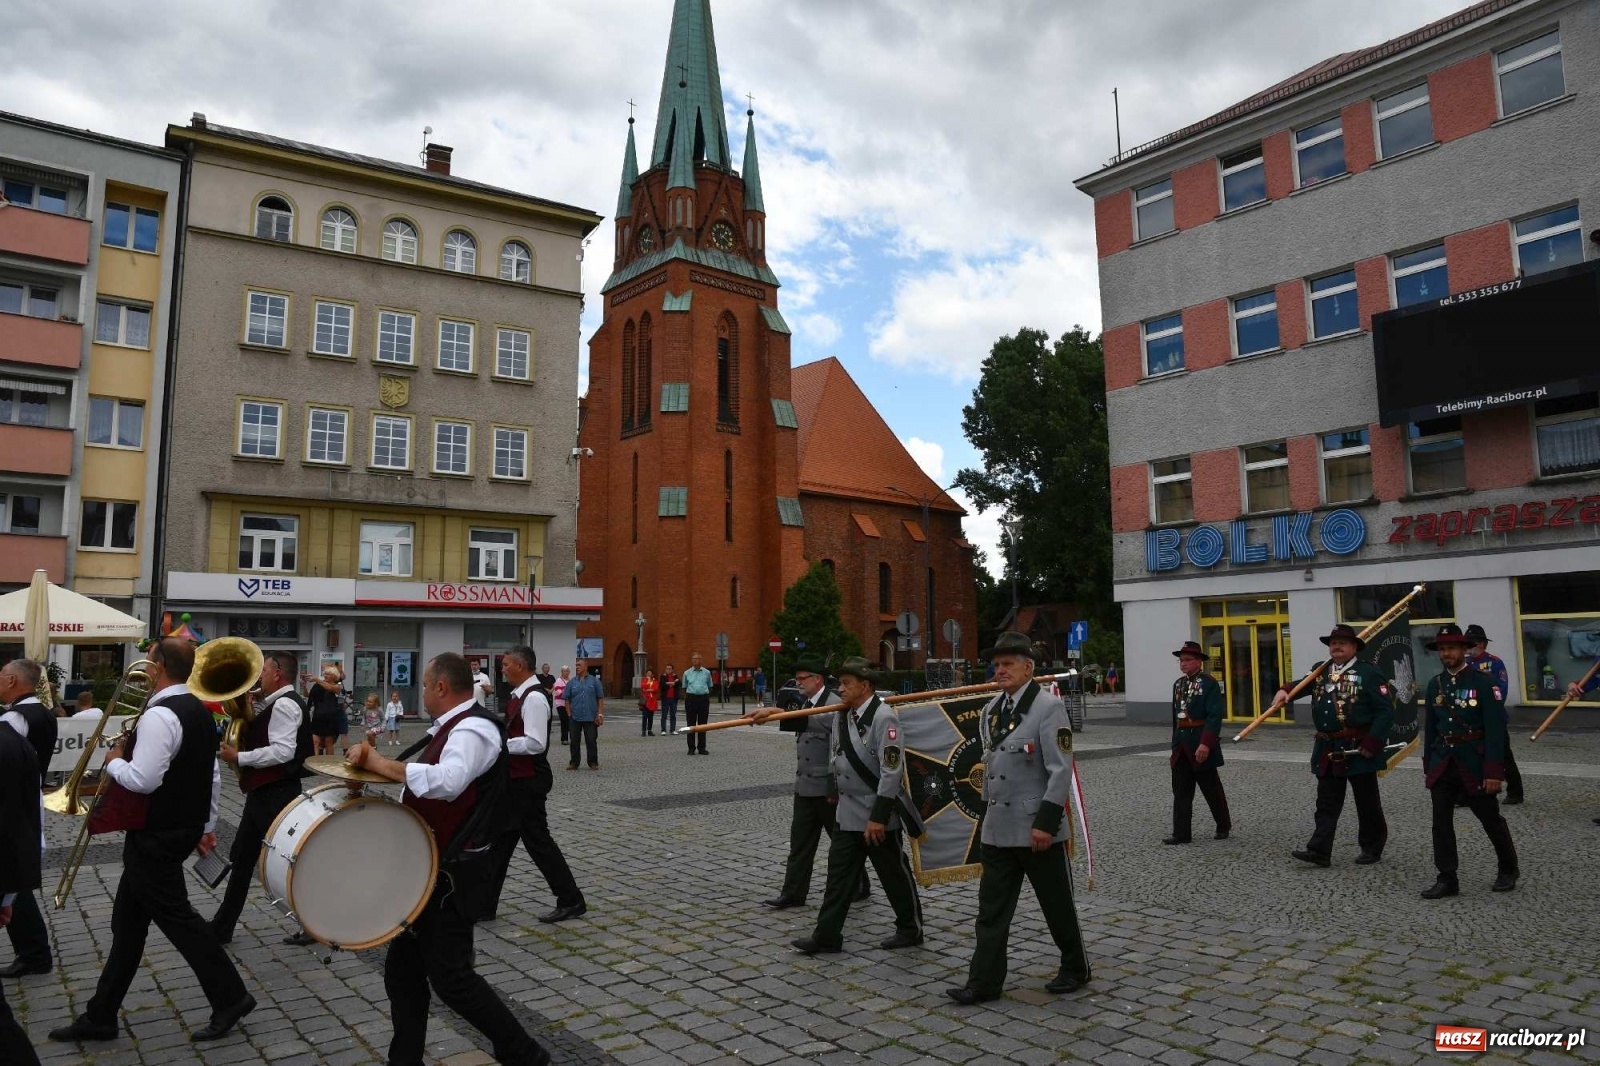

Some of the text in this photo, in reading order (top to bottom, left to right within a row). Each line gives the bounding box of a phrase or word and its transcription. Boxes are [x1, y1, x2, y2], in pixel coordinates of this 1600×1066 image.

[1439, 280, 1522, 306] tel. 533 355 677
[1436, 386, 1548, 414] Telebimy-Raciborz.pl
[1146, 494, 1600, 572] BOLKO zaprasza
[262, 579, 291, 590] TEB
[427, 584, 541, 603] ROSSMANN
[0, 622, 84, 632] RACRSKIE
